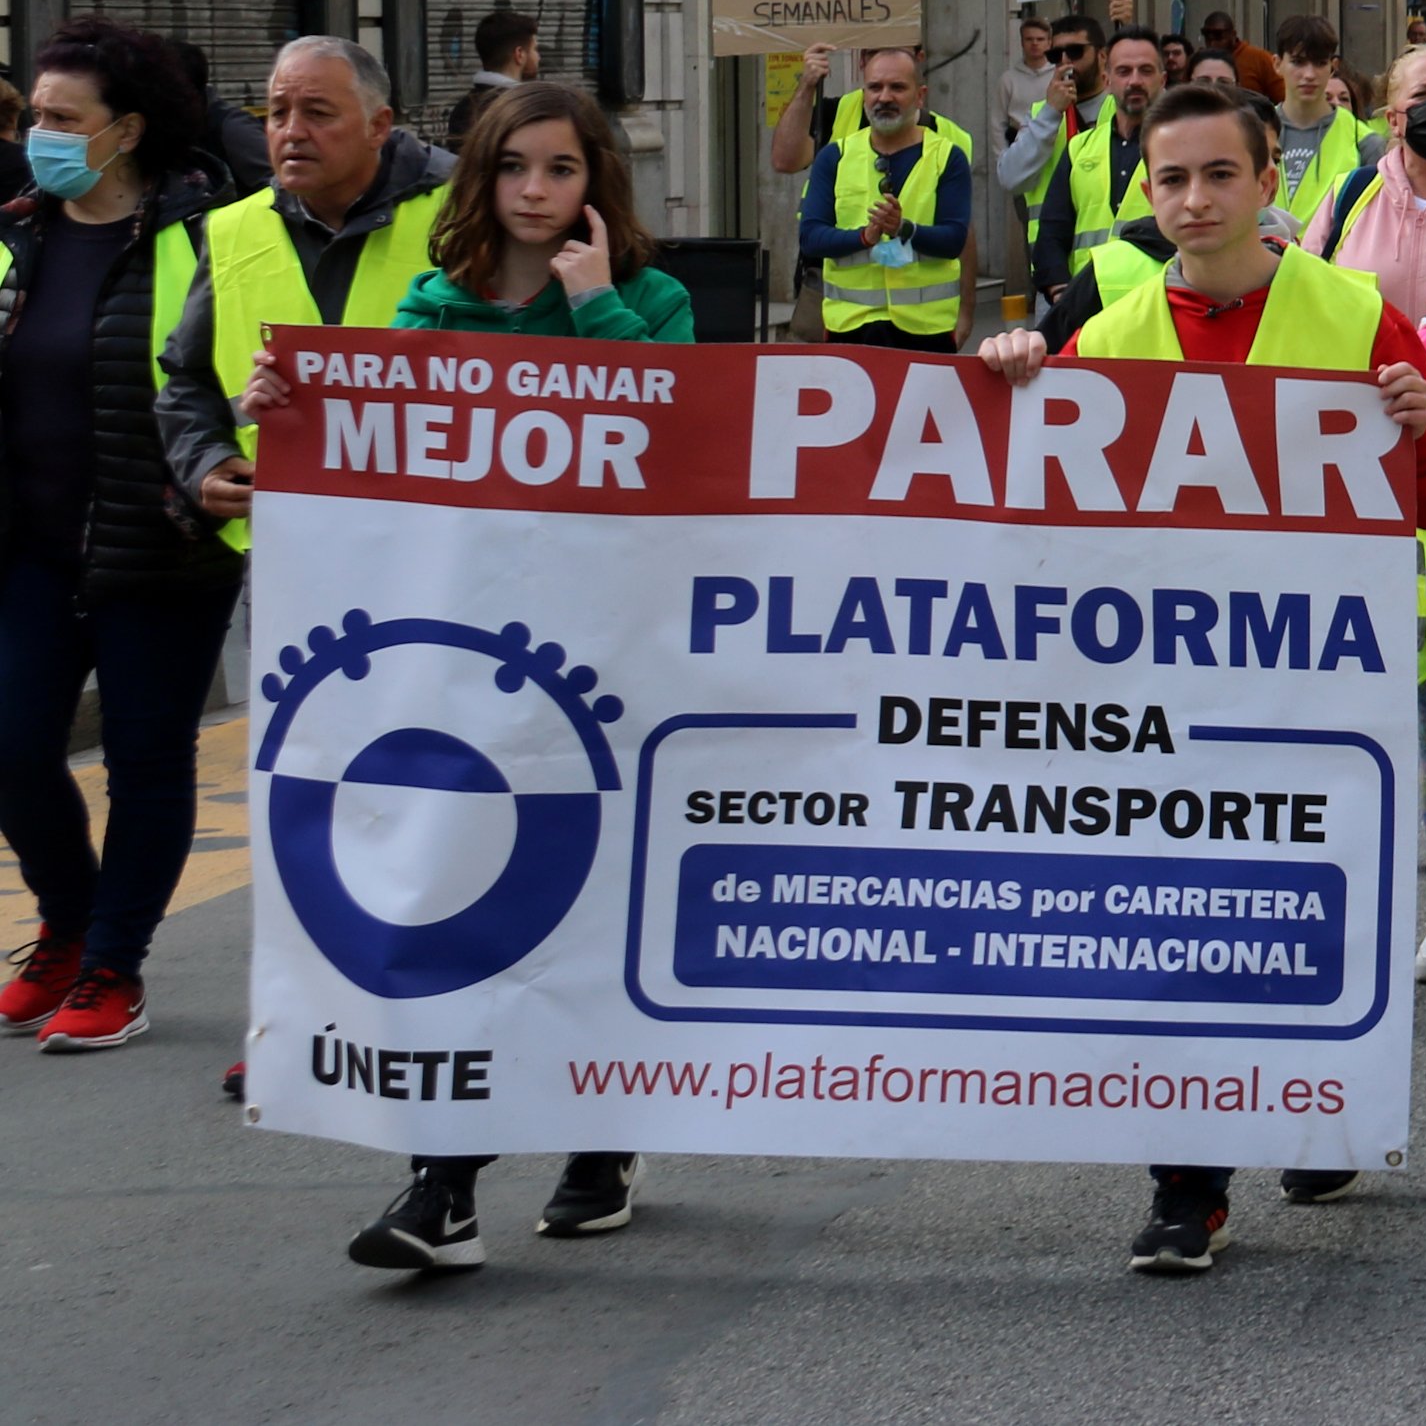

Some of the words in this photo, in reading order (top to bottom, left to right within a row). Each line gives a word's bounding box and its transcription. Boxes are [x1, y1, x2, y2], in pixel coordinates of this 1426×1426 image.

[296, 350, 416, 390] PARA
[427, 356, 494, 394] NO
[506, 360, 676, 404] GANAR
[323, 398, 650, 489] MEJOR
[749, 355, 1405, 520] PARAR
[689, 575, 1387, 673] PLATAFORMA
[878, 695, 1176, 754] DEFENSA
[685, 790, 870, 827] SECTOR
[894, 780, 1328, 843] TRANSPORTE
[712, 873, 761, 905] de
[771, 874, 1021, 911] MERCANCIAS
[1031, 888, 1096, 917] por
[1104, 884, 1326, 921] CARRETERA
[715, 925, 937, 964] NACIONAL
[972, 931, 1318, 976] INTERNACIONAL
[312, 1022, 494, 1101] ÚNETE
[569, 1052, 1346, 1115] www.plataformanacional.es
